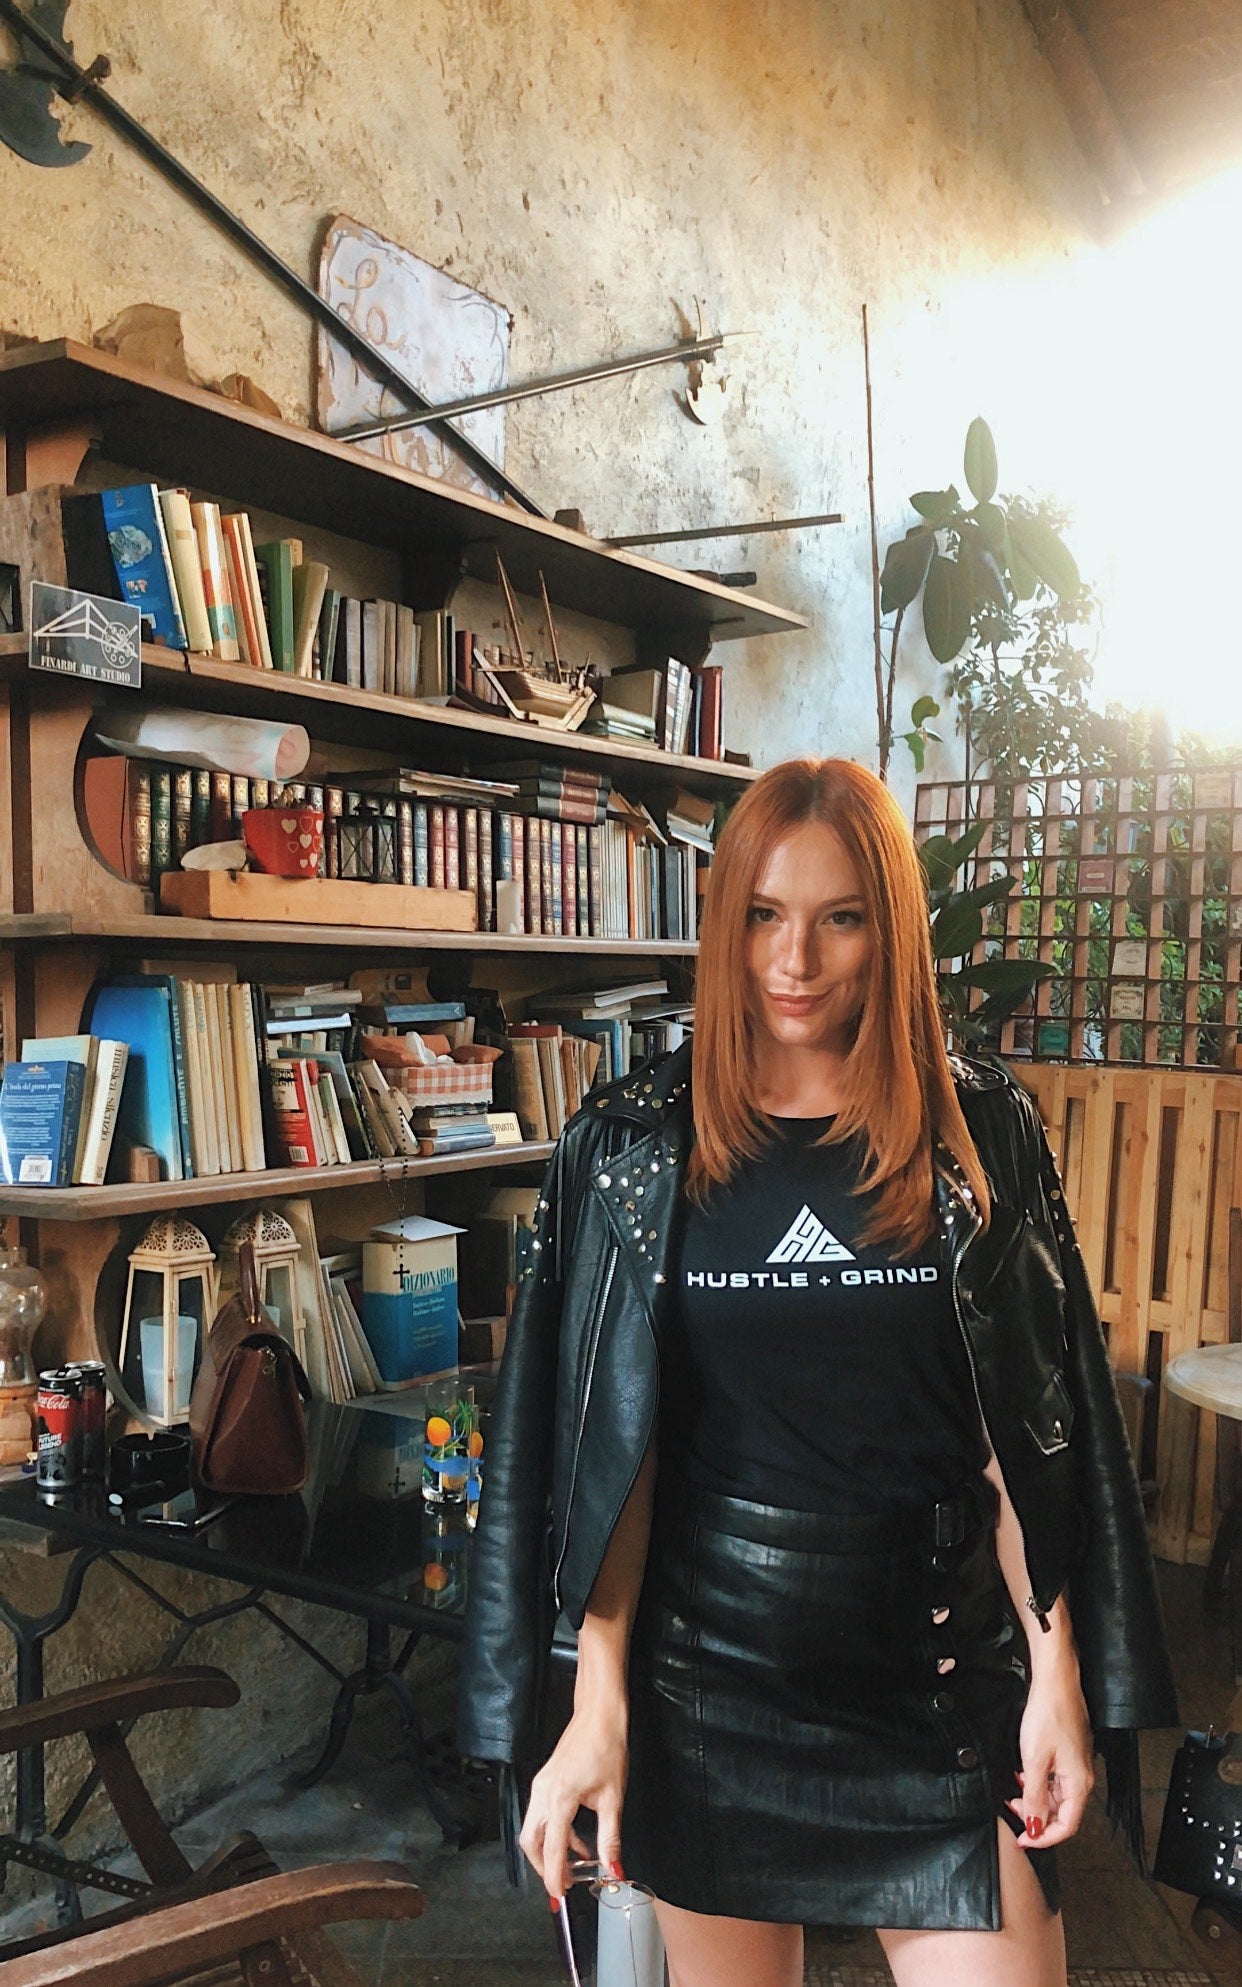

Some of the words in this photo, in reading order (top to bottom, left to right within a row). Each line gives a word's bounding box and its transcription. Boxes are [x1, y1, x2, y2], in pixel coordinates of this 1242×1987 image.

[79, 662, 98, 677] ART
[100, 668, 131, 684] STUDIO
[109, 1049, 124, 1091] musica
[101, 1097, 116, 1142] silenzio
[402, 1267, 455, 1291] DIZIONARIO
[687, 1271, 810, 1288] HUSTLE
[819, 1275, 831, 1287] +
[840, 1266, 939, 1286] GRIND
